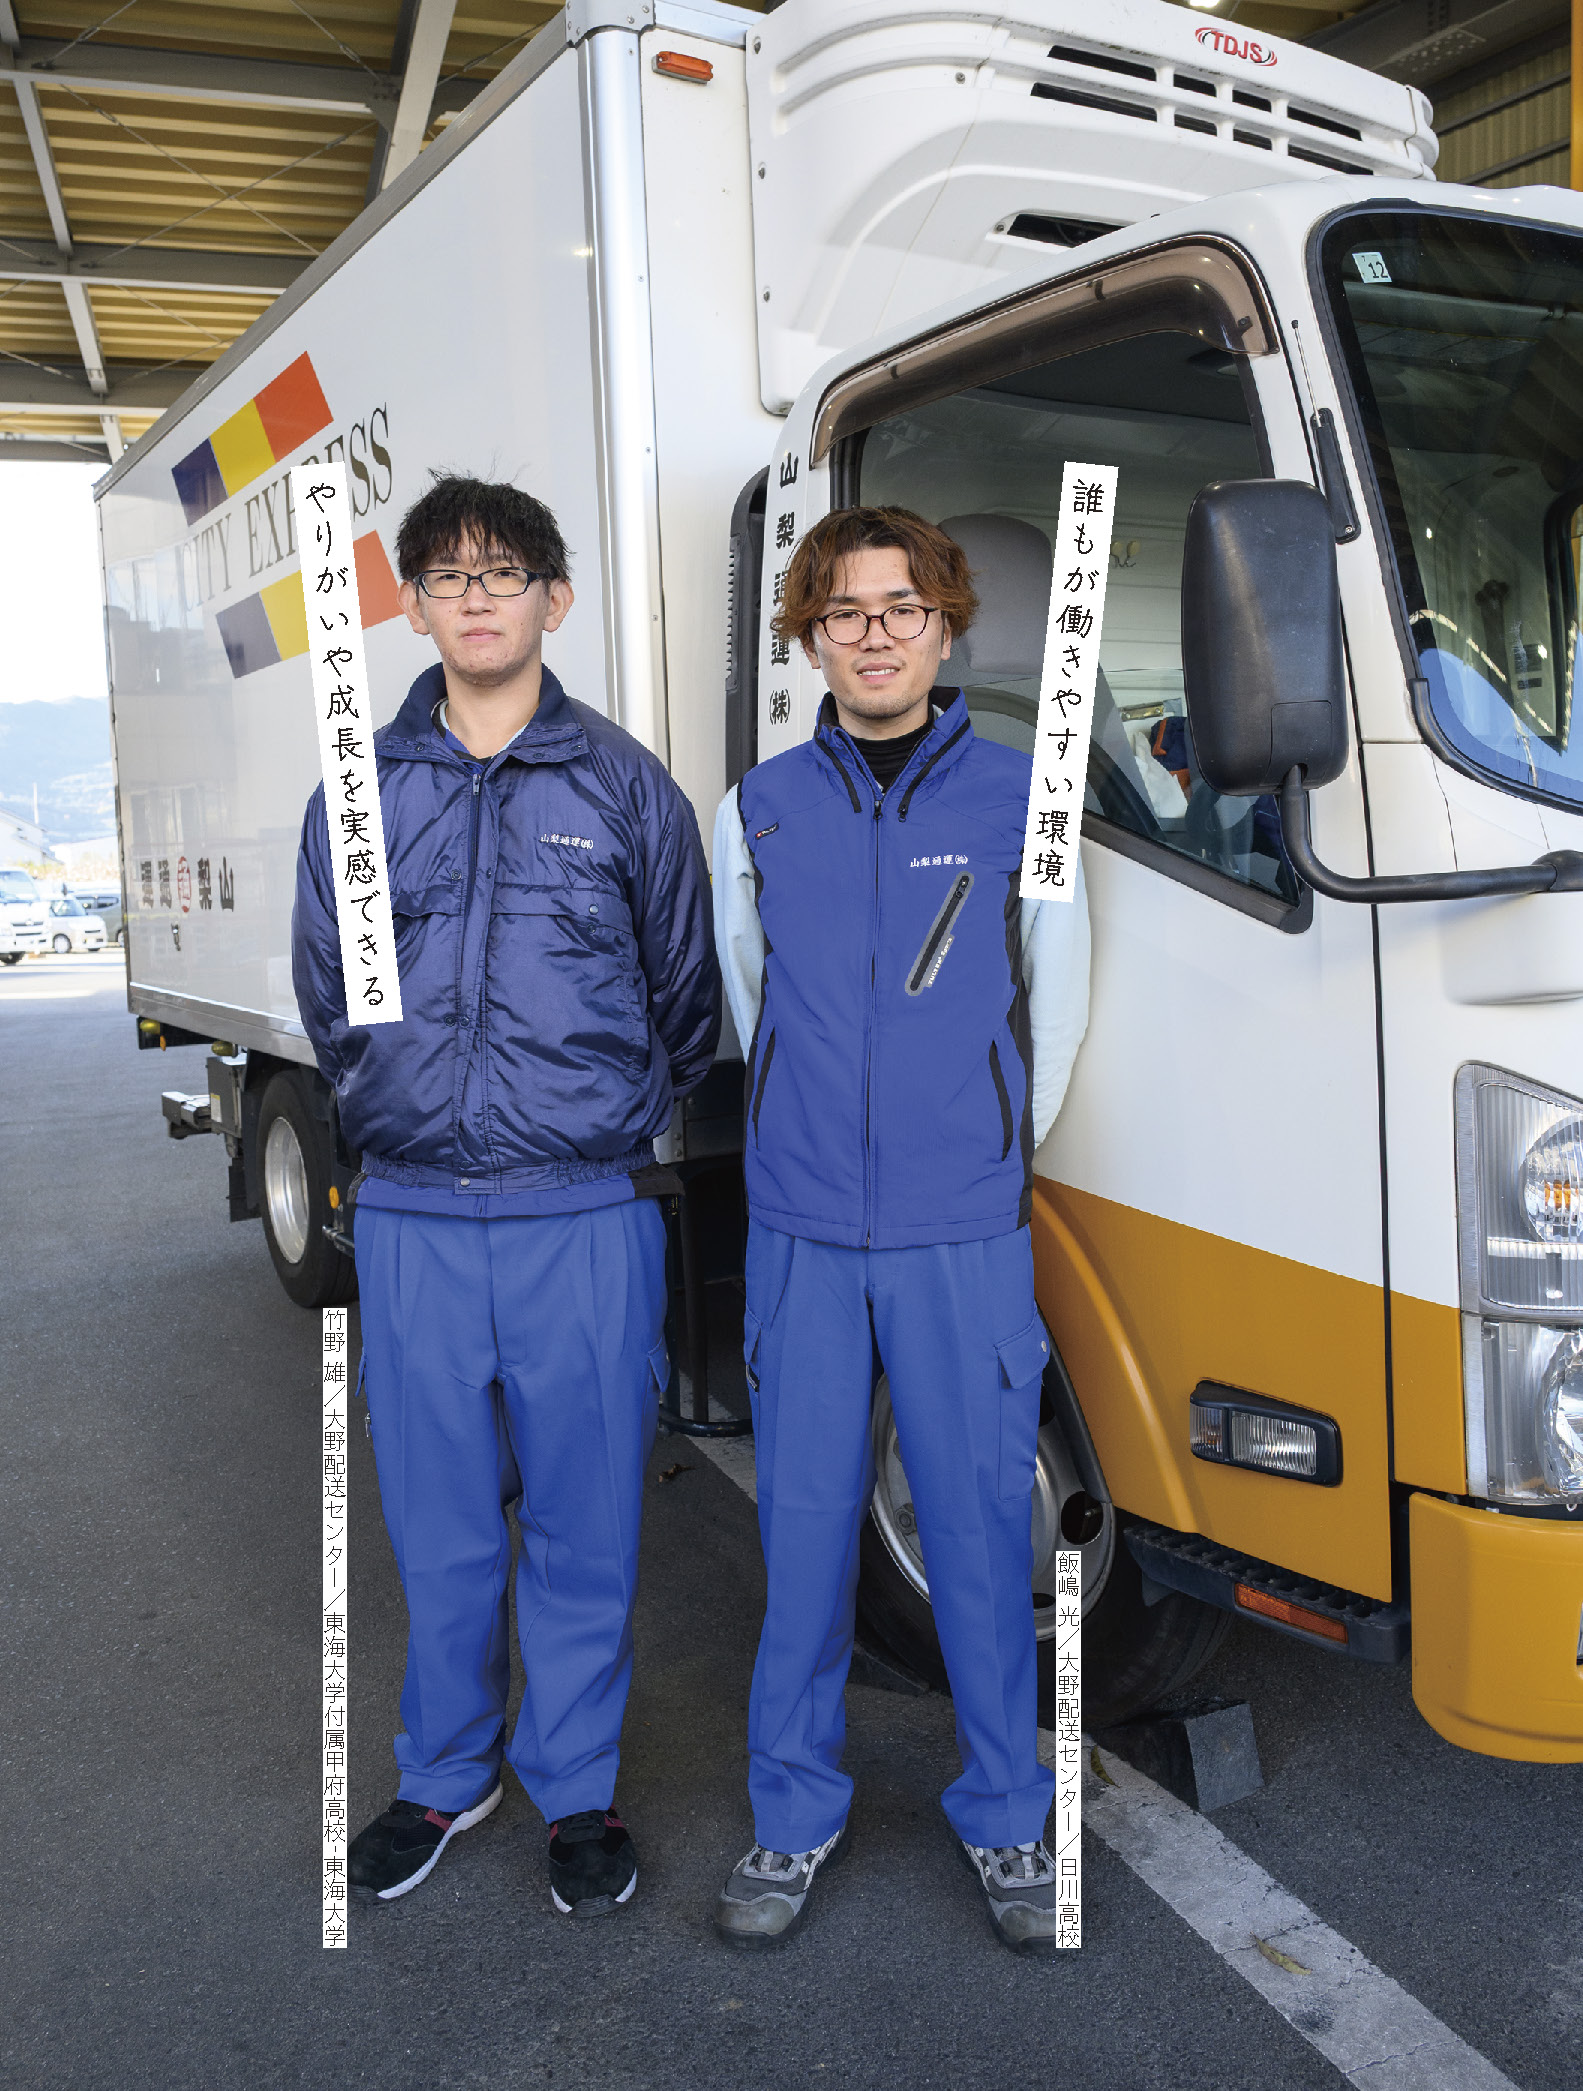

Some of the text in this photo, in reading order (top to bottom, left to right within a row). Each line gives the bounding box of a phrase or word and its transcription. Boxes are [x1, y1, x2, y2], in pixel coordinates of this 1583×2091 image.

[1210, 30, 1263, 63] TDJS
[1368, 261, 1388, 279] 12
[176, 402, 392, 612] CITY EXSS
